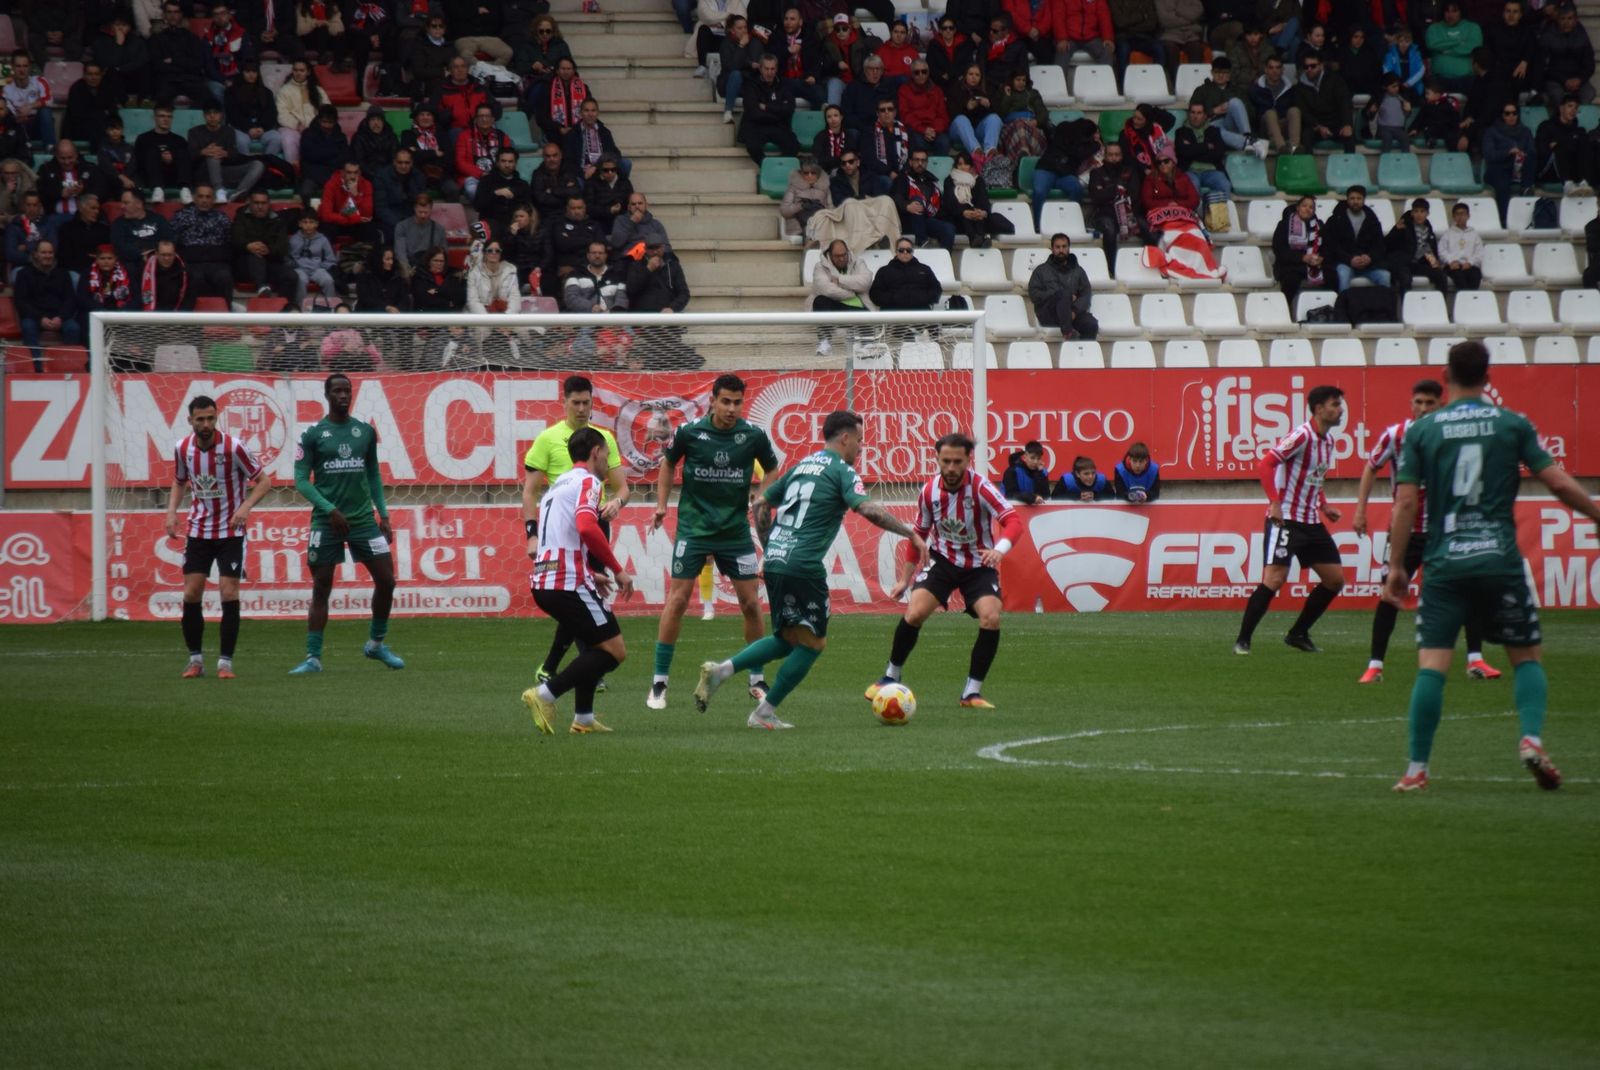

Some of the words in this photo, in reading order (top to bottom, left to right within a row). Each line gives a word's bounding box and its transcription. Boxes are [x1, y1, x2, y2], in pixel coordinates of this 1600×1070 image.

[777, 410, 960, 444] CETRO
[859, 446, 1056, 476] ROBRTO
[1216, 422, 1371, 470] reapt
[694, 466, 744, 480] columbia
[1452, 443, 1484, 506] 4
[776, 481, 816, 529] 21
[309, 530, 322, 548] 14
[420, 518, 465, 539] del
[1278, 529, 1290, 547] 5
[674, 539, 688, 558] 6
[1147, 531, 1418, 584] FRIA
